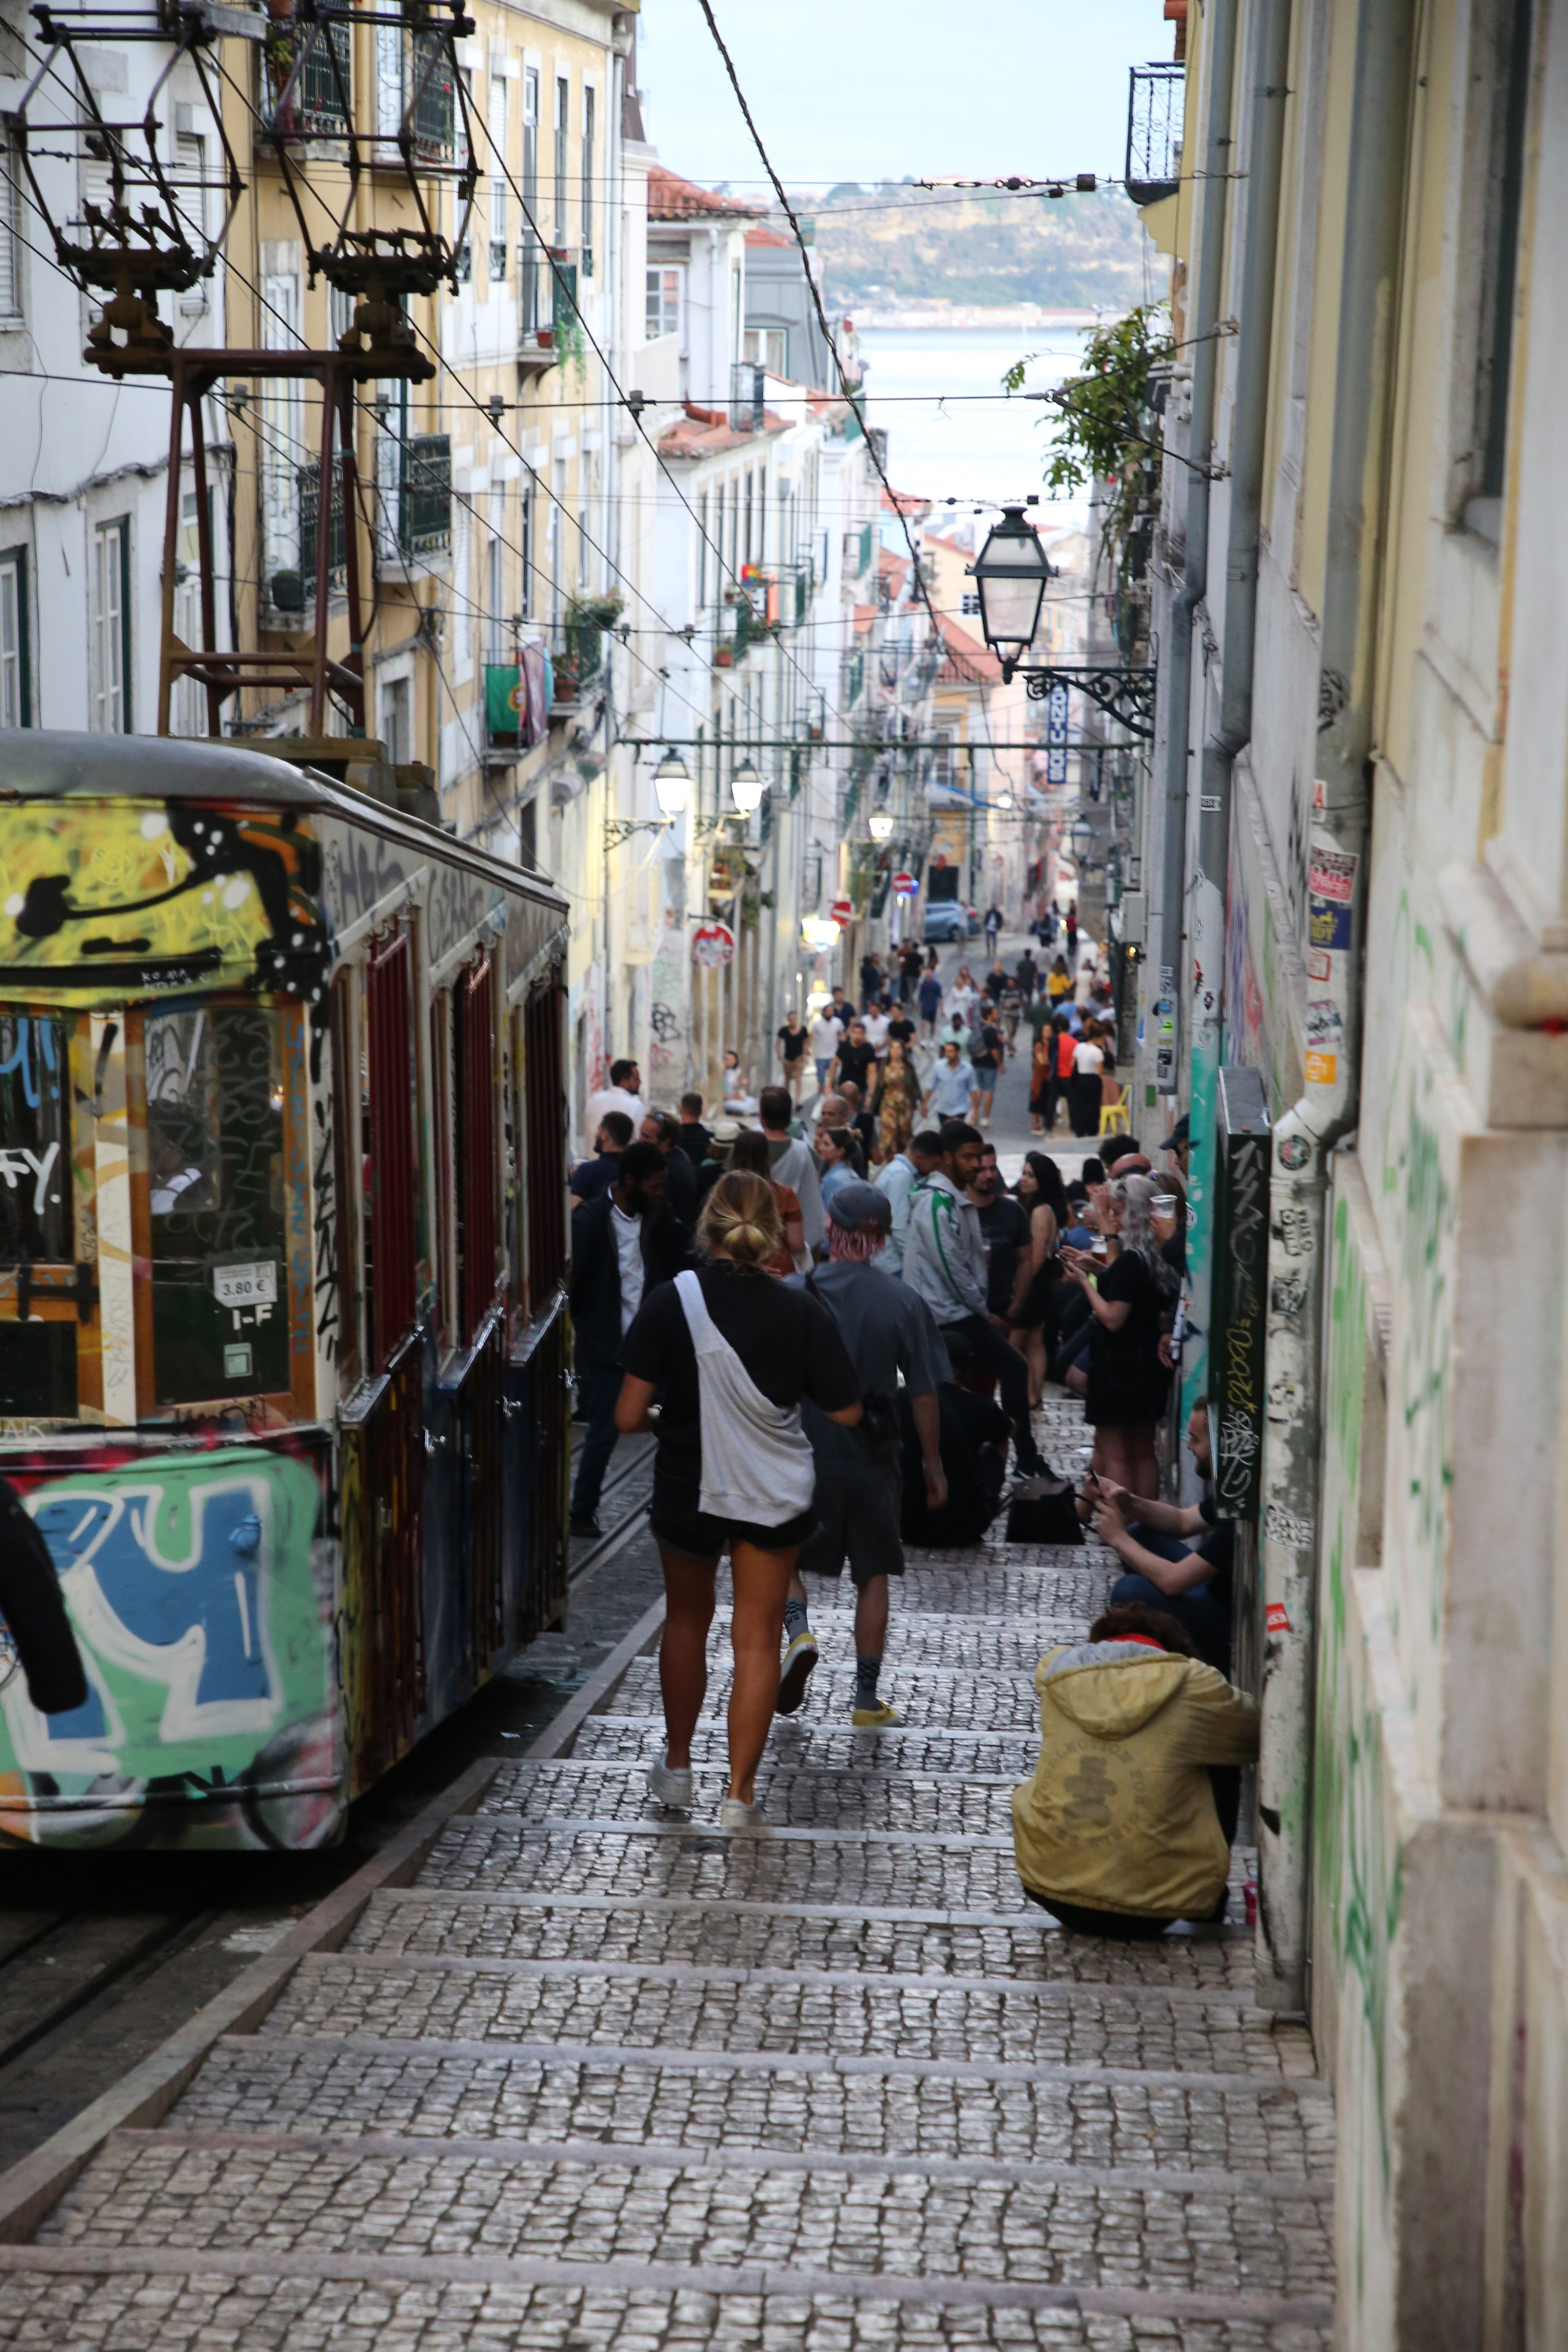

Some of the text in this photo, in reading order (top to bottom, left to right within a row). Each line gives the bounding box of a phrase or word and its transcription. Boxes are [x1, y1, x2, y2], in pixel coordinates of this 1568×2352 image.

[1049, 680, 1068, 782] ONTUOS
[222, 1279, 266, 1297] 3.80 €
